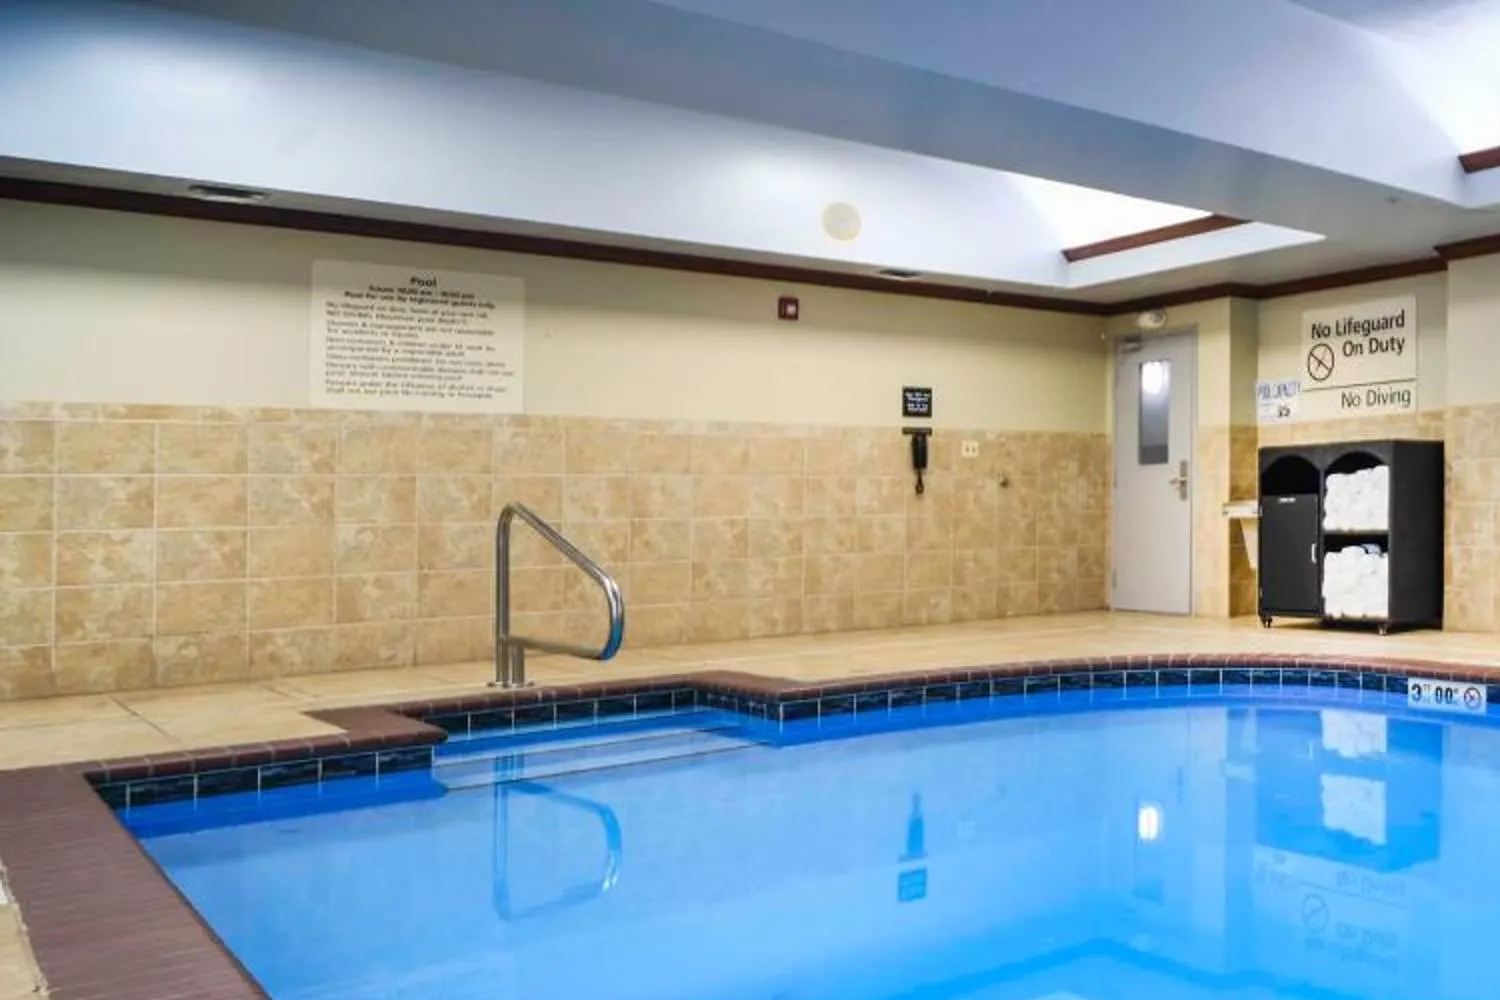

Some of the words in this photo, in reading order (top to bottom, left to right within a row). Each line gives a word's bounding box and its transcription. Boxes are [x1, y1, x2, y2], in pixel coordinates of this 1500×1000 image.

[1311, 323, 1331, 339] No
[1335, 309, 1405, 337] Lifeguard
[1342, 341, 1363, 357] On
[1369, 337, 1405, 355] Duty
[1341, 391, 1361, 409] No
[1366, 389, 1411, 409] Diving
